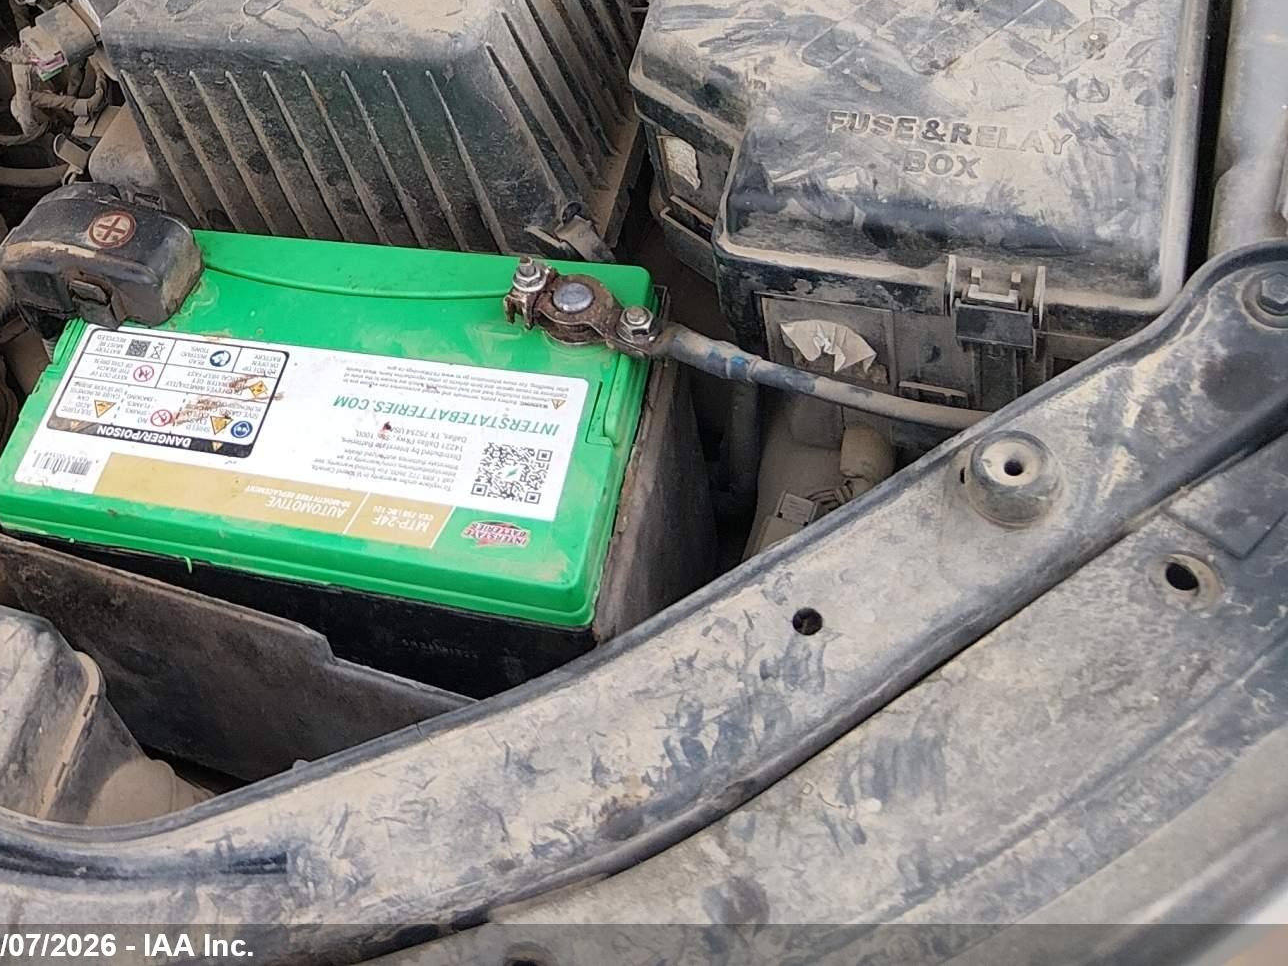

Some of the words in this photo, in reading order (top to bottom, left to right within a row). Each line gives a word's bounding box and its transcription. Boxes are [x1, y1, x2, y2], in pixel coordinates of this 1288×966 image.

[827, 110, 1074, 155] FUSE&RELAY
[902, 150, 980, 179] BOX
[332, 394, 560, 436] INTERSTATEBATTERIES.COM
[95, 424, 193, 447] DANGER/POISON
[415, 438, 439, 448] Dallas
[420, 448, 462, 460] Distributed
[262, 495, 347, 518] AUTOMOTIVE
[369, 512, 431, 532] MTP-24F
[471, 523, 527, 538] BATTERIES
[464, 530, 528, 547] INTERSTATE
